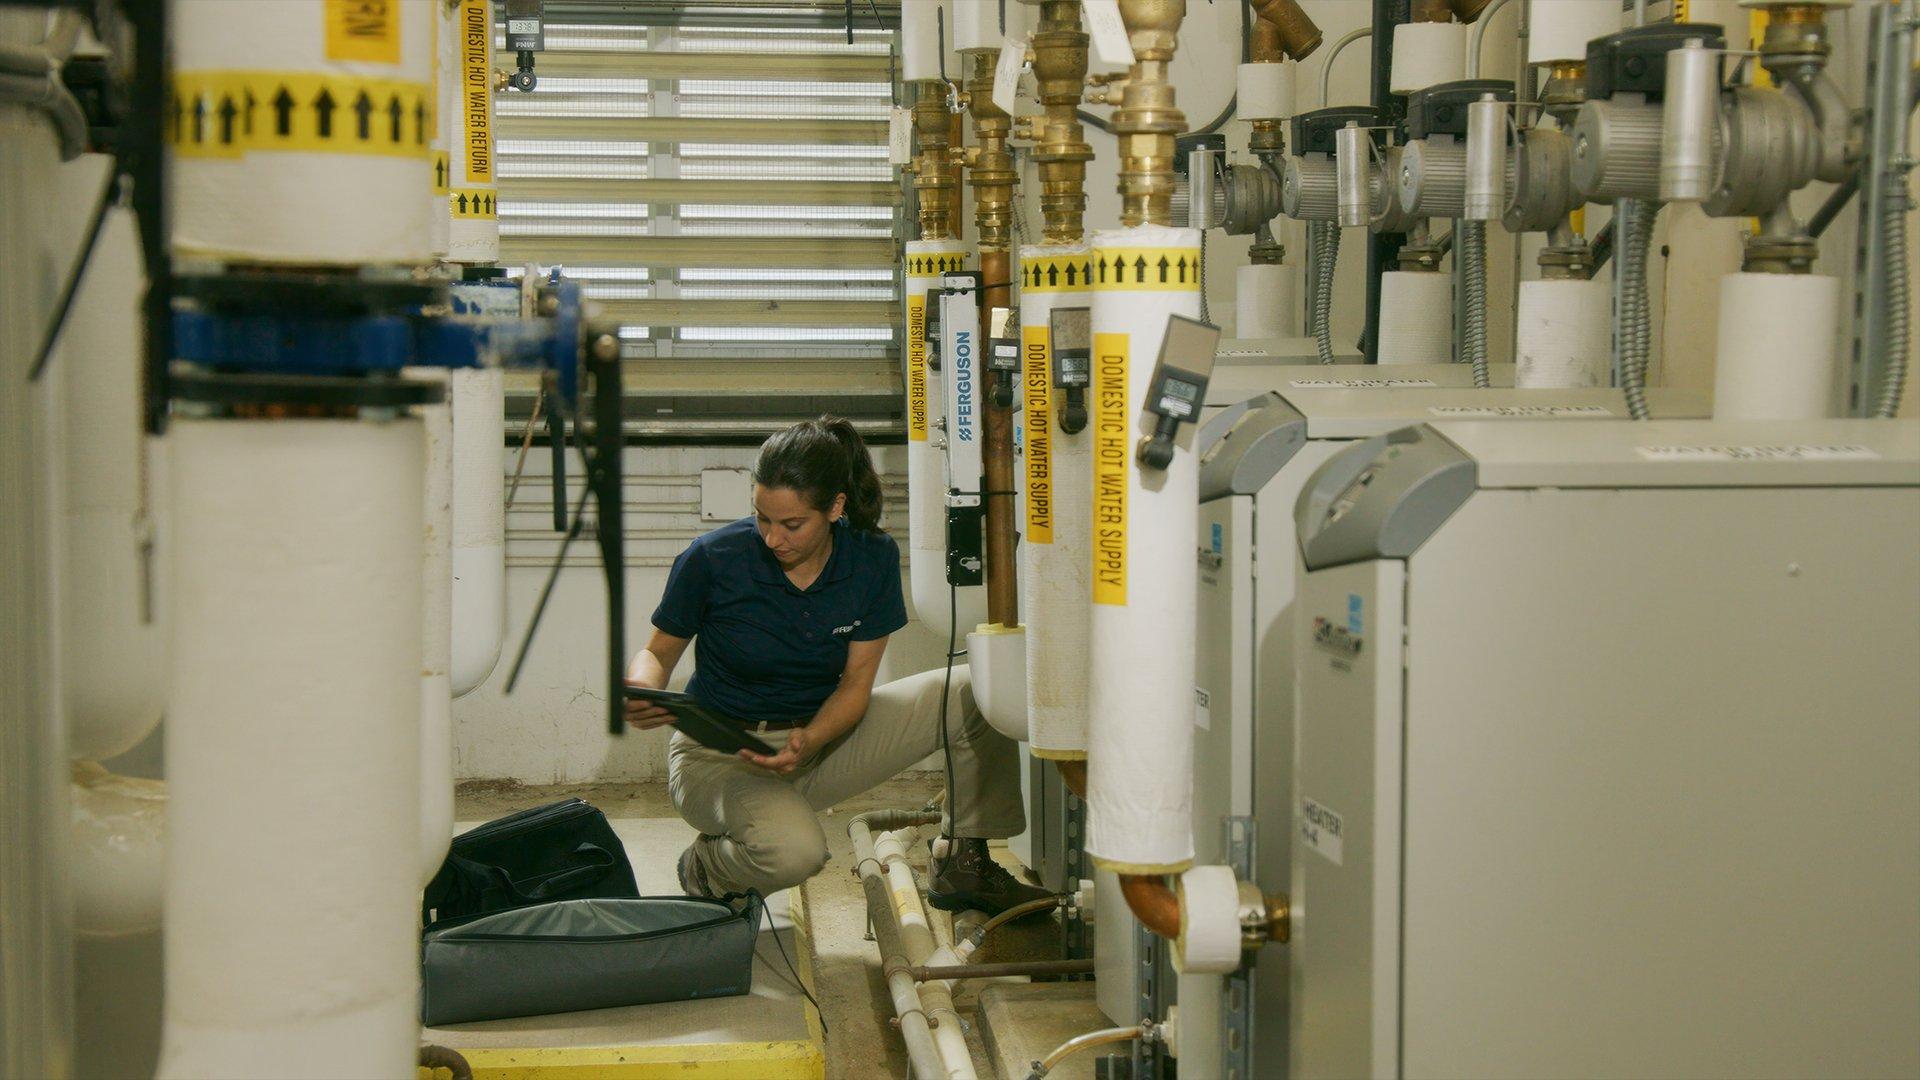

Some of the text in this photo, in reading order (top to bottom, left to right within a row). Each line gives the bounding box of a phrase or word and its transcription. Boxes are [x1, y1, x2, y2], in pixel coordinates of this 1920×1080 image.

[467, 7, 488, 173] DOMESTIC HOT WATER RETURN
[910, 306, 925, 431] DOMESTIC HOT WATER SUPPLY
[956, 331, 972, 426] FERGUSON
[1028, 344, 1049, 529] DOMESTIC HOT WATER SUPPLY
[1099, 355, 1124, 587] DOMESTIC HOT WATER SUPPLY
